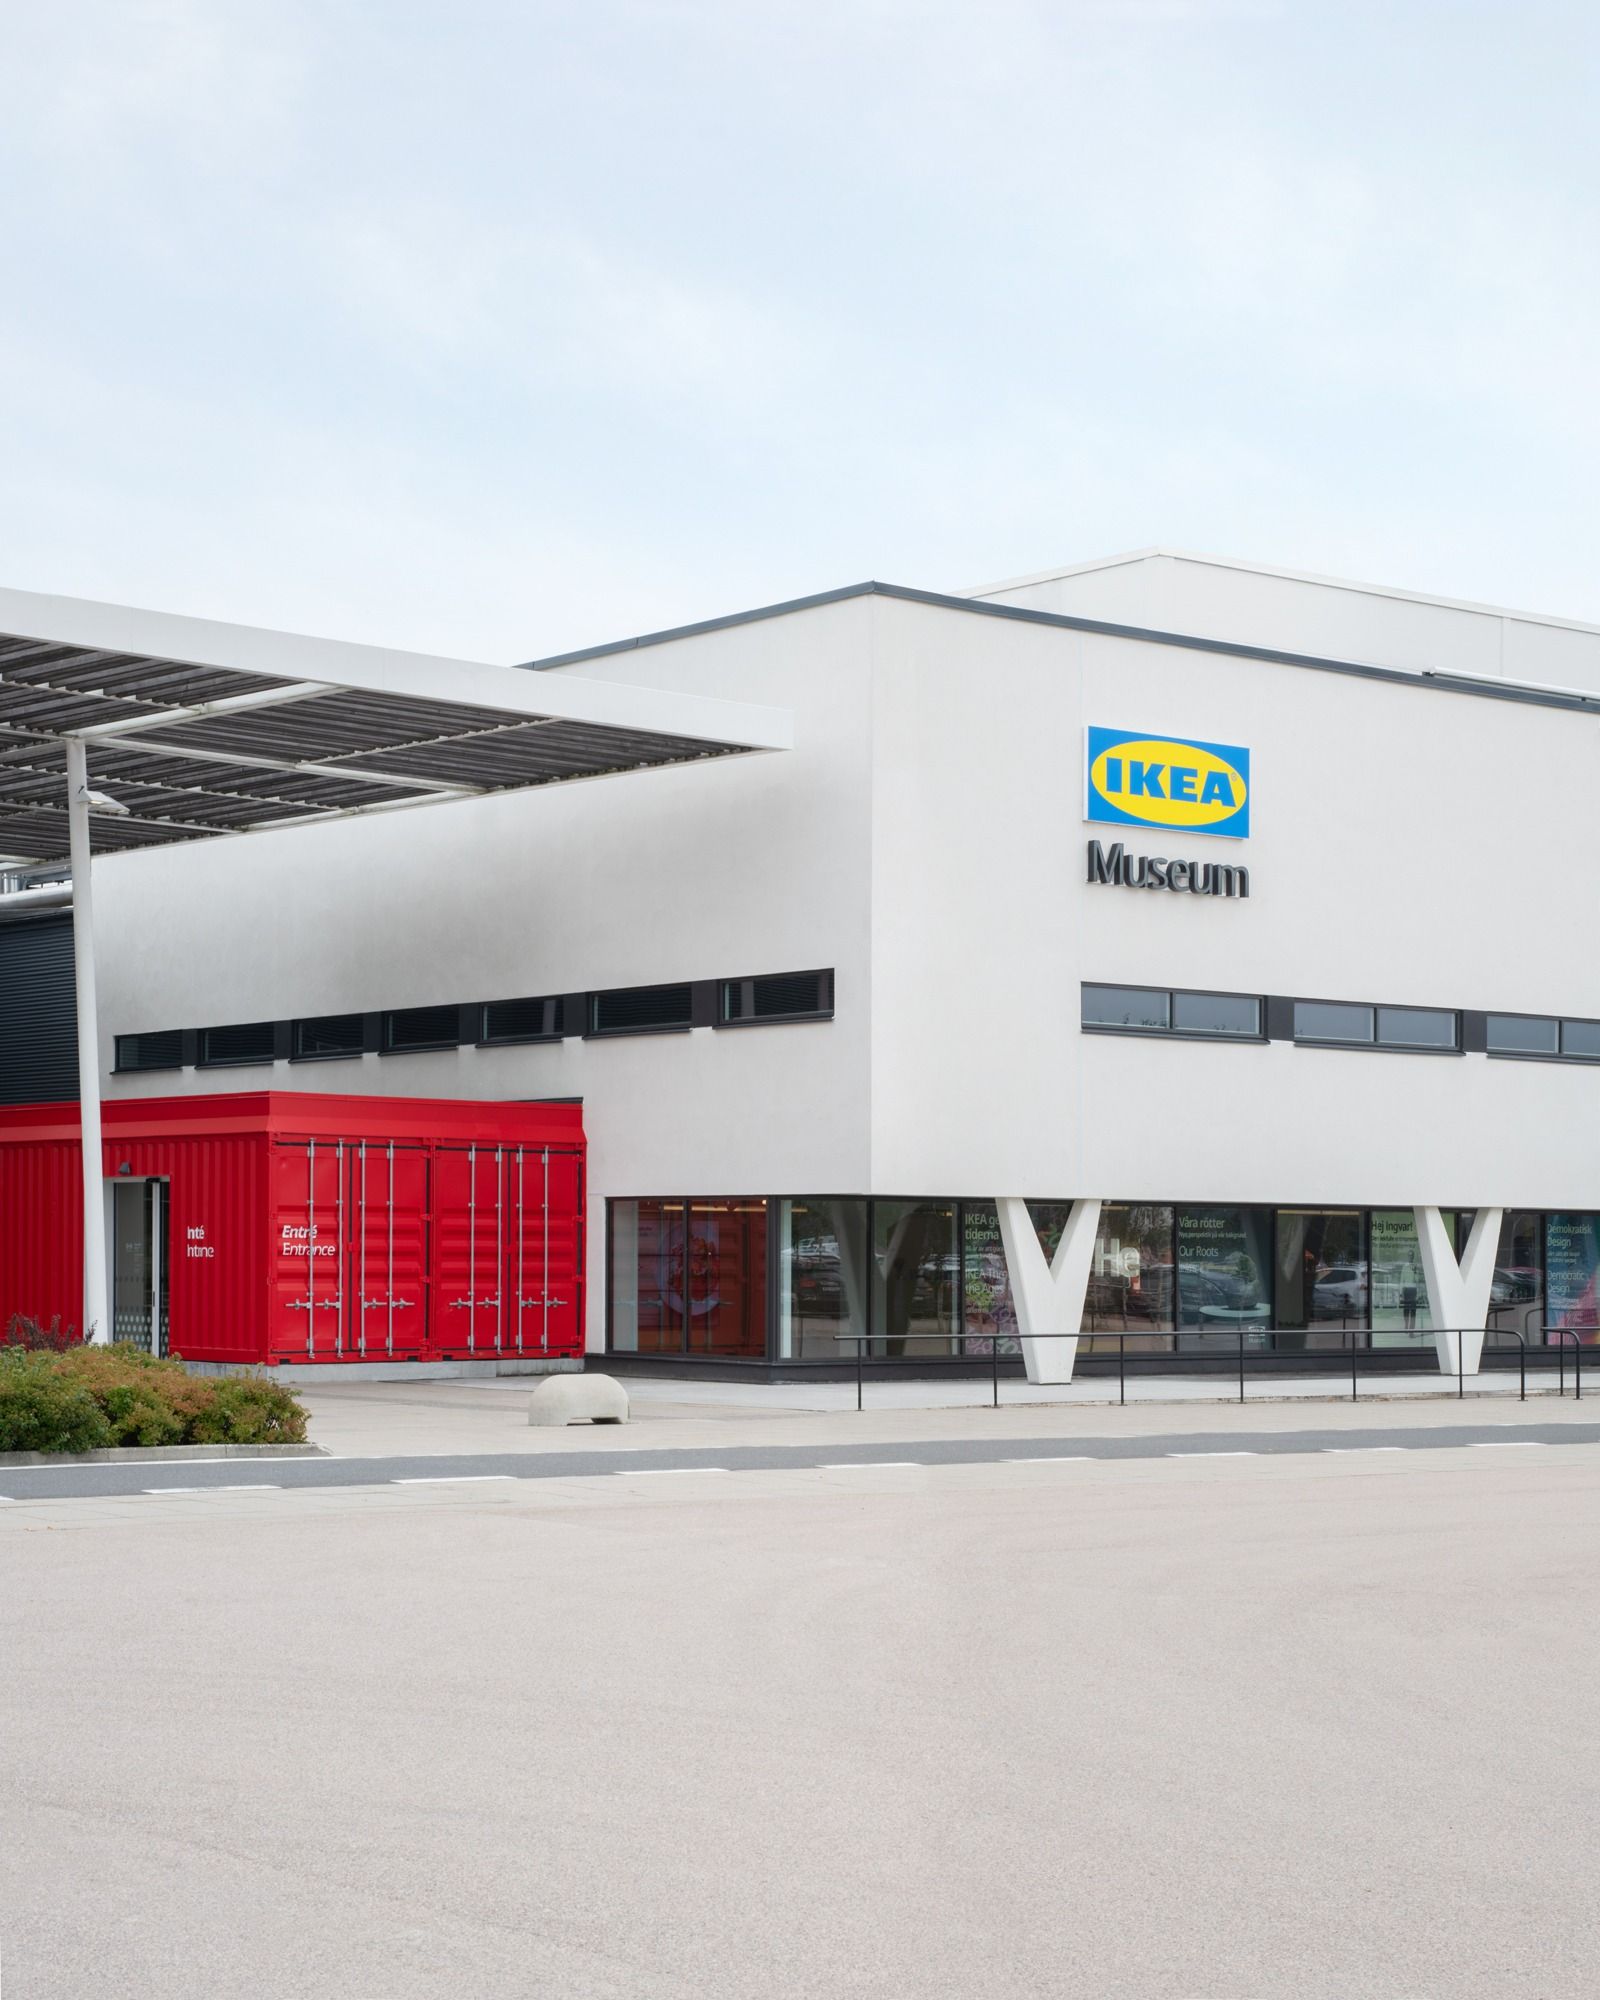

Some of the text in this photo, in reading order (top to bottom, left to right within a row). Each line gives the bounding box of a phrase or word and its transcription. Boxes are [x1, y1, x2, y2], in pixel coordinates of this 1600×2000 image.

[1106, 757, 1236, 807] IKEA
[1087, 840, 1250, 898] Museum
[965, 1213, 988, 1225] IKEA
[1178, 1215, 1225, 1229] Våra rötter
[1371, 1220, 1413, 1234] Hej Ingvar!
[1547, 1223, 1593, 1234] Demokratisk
[1547, 1236, 1572, 1249] Design
[1179, 1245, 1219, 1257] Our Roots
[1547, 1270, 1585, 1281] Democratic
[1547, 1283, 1570, 1296] Design
